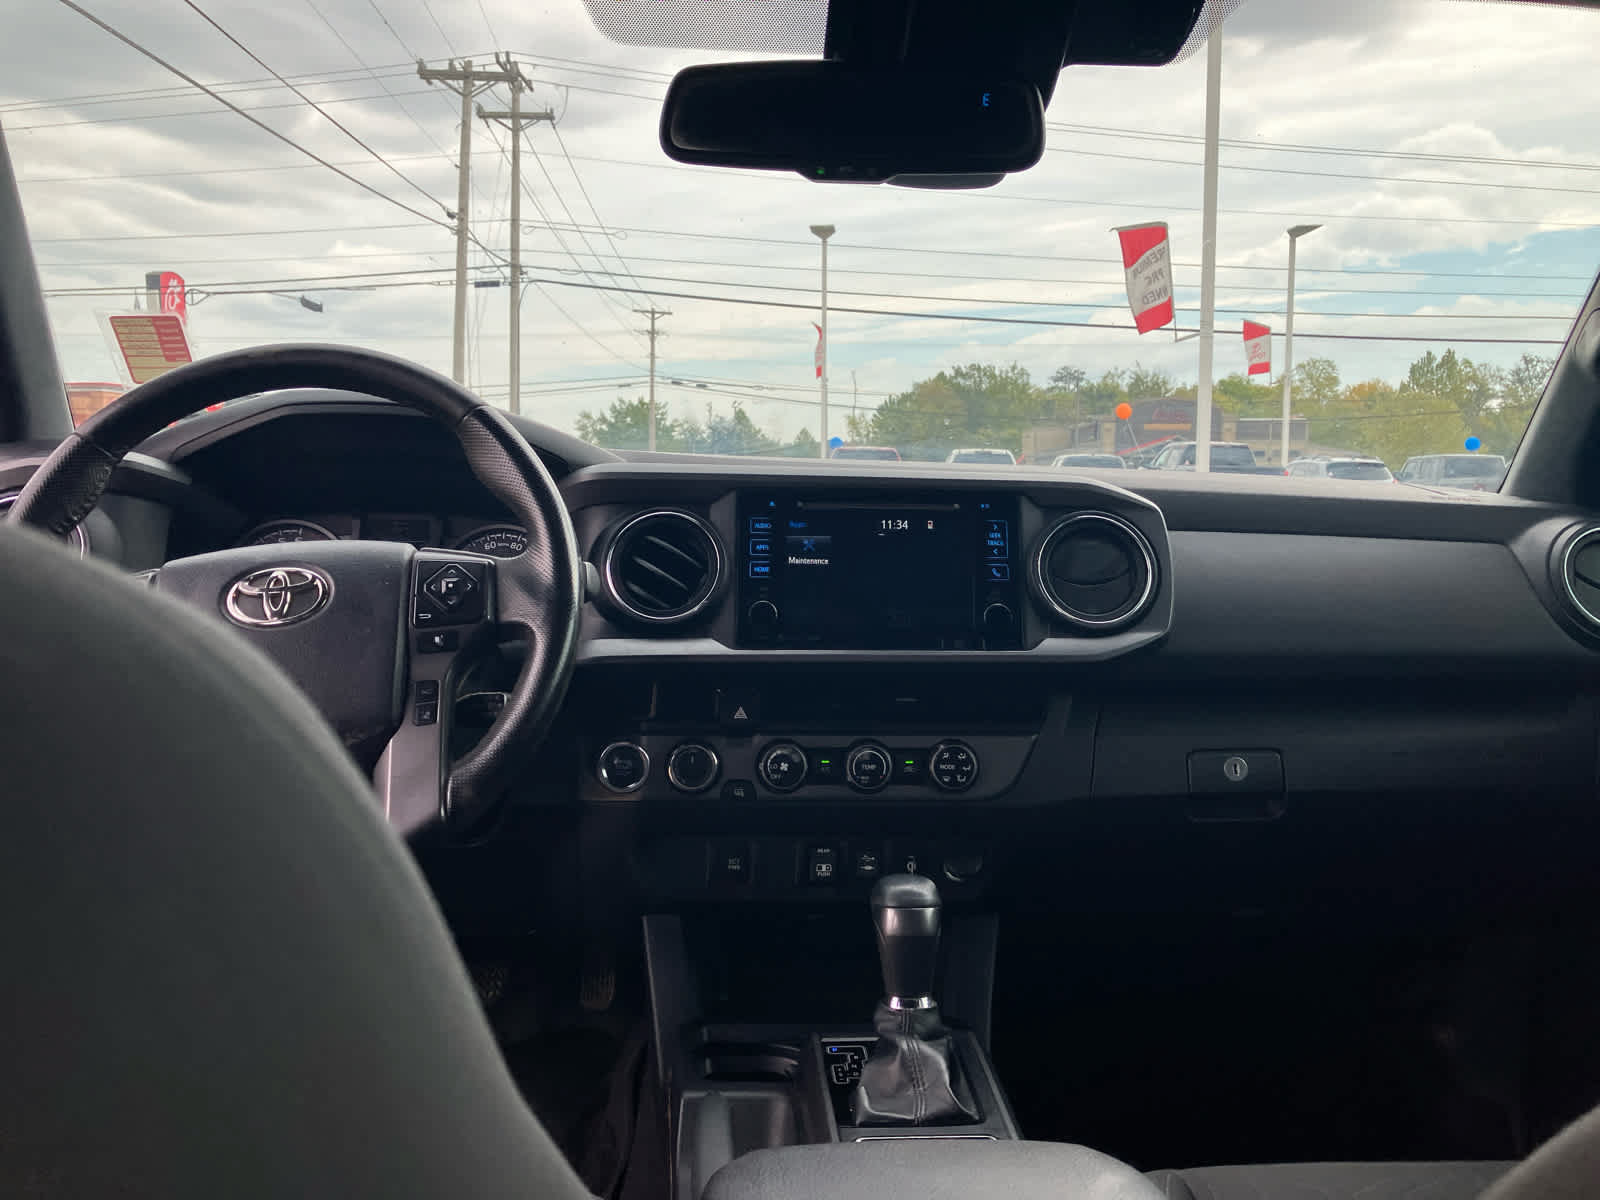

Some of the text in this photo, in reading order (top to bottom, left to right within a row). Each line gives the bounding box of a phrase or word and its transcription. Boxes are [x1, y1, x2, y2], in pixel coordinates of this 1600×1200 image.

[982, 93, 990, 107] E
[881, 519, 909, 530] 11:34
[484, 541, 497, 550] 60
[510, 542, 523, 551] 80
[788, 556, 829, 565] Maintenance
